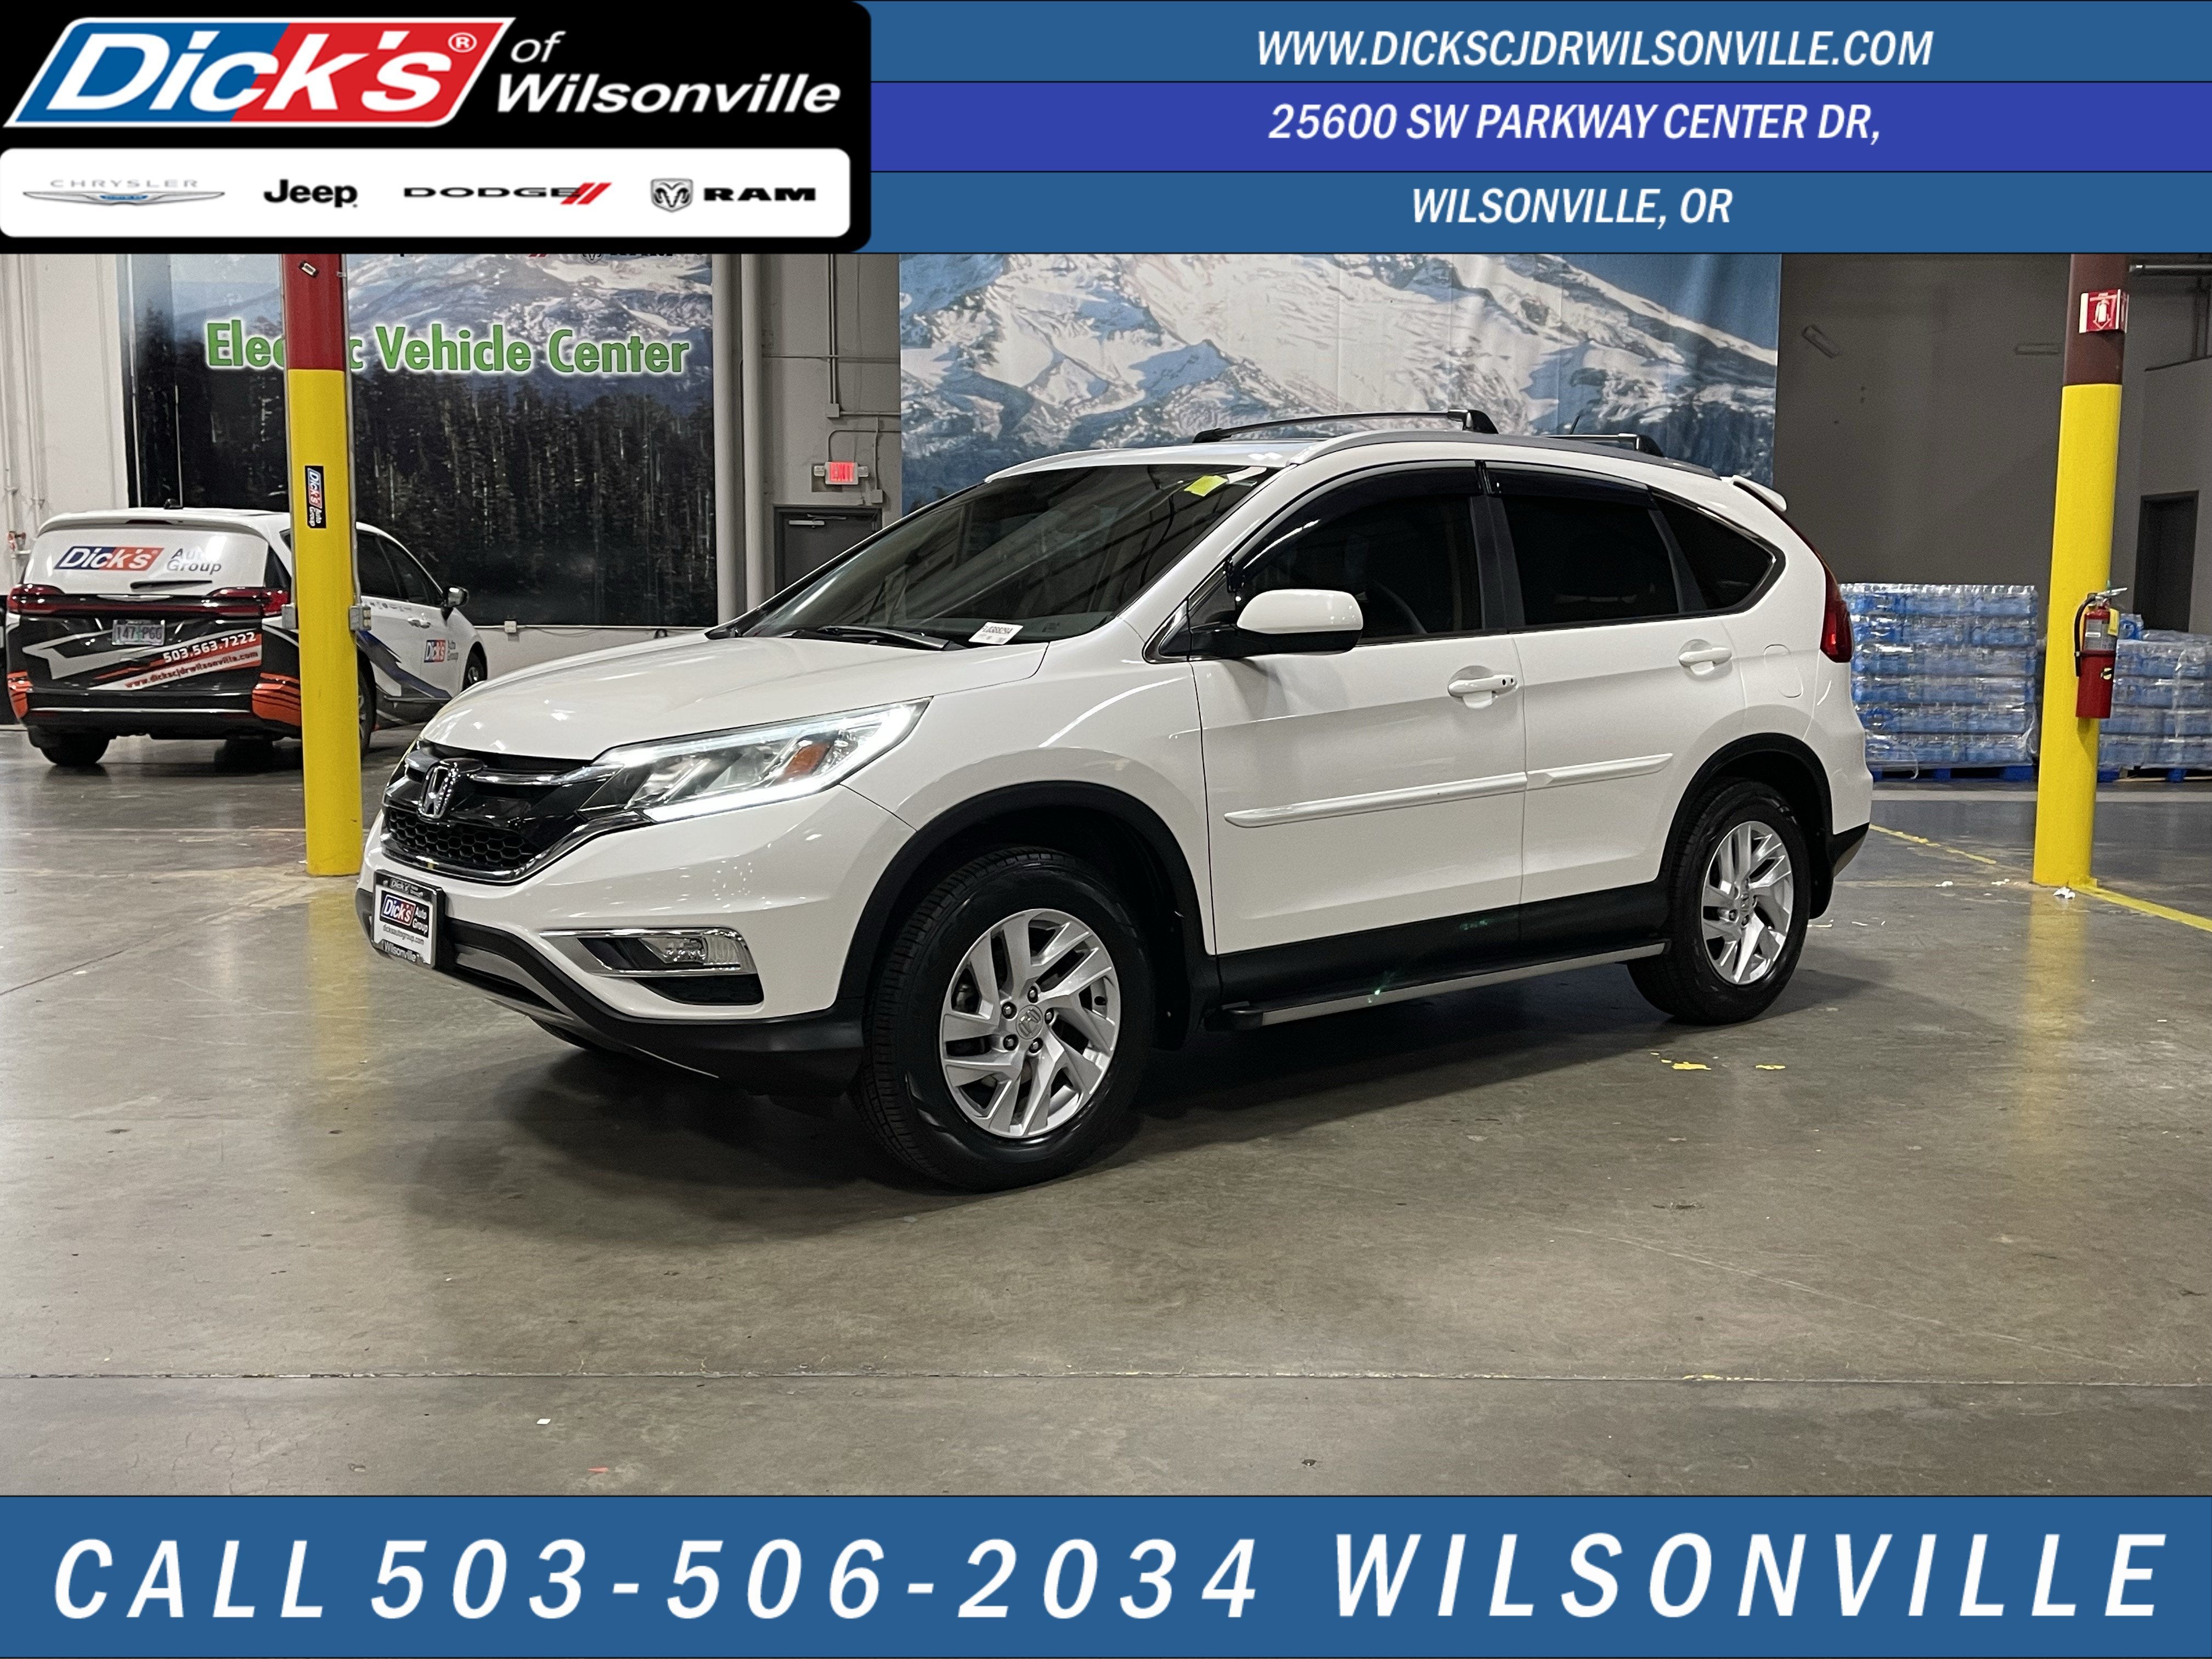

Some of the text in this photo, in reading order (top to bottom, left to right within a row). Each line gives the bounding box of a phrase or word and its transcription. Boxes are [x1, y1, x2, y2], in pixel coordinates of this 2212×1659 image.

[207, 320, 690, 373] Elec Vehicle Center
[309, 471, 321, 504] Dick's
[58, 548, 152, 569] Dick's
[167, 559, 222, 575] Group
[163, 631, 257, 663] 503.563.7222
[383, 899, 412, 923] Dick's
[415, 906, 427, 919] Auto
[412, 918, 428, 935] Group
